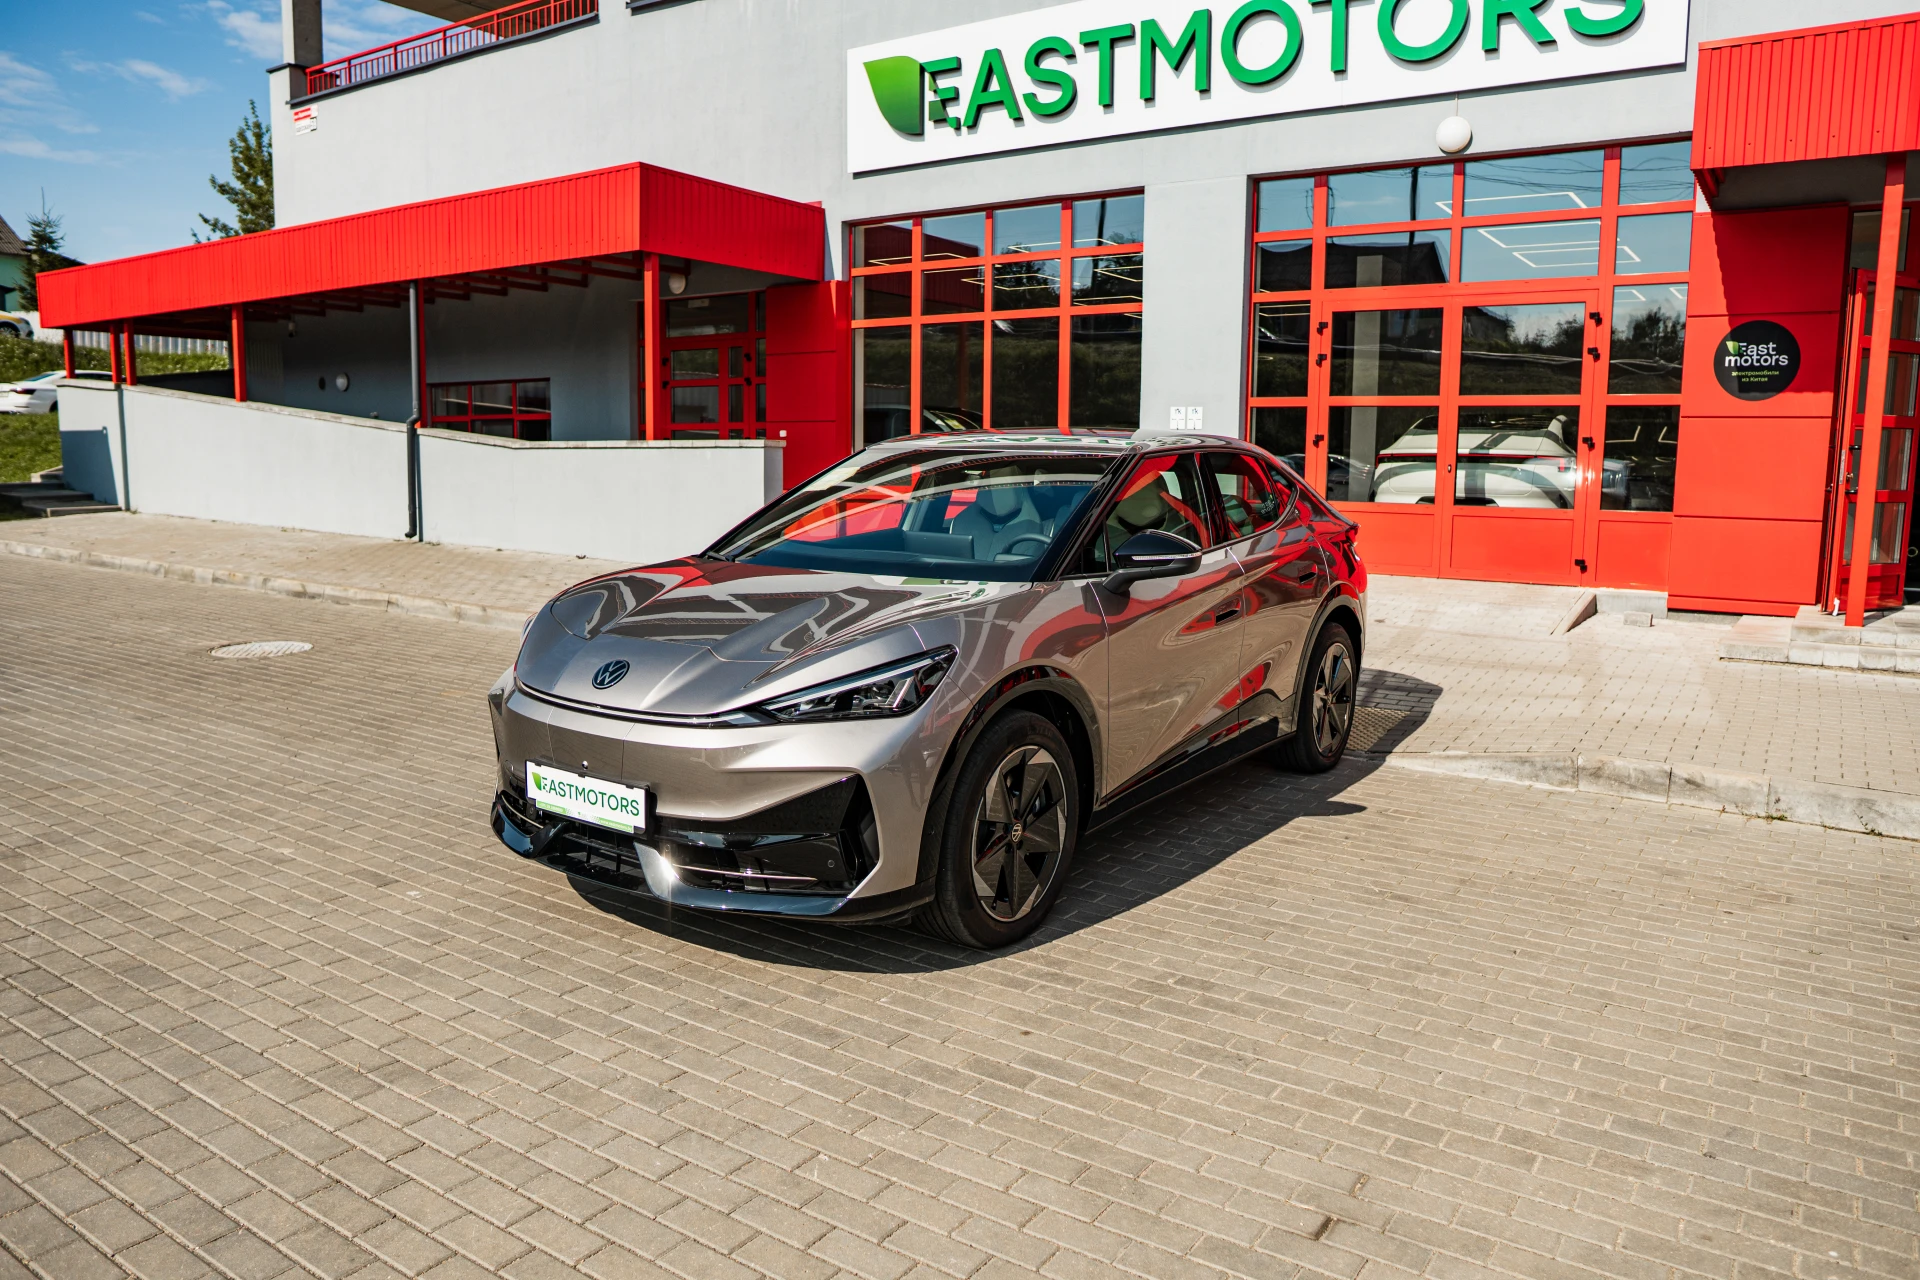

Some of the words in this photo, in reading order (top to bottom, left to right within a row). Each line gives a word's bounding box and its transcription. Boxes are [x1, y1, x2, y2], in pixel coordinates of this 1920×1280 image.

[1738, 341, 1777, 355] East
[1724, 355, 1789, 367] motors
[541, 776, 640, 817] EASTMOTORS
